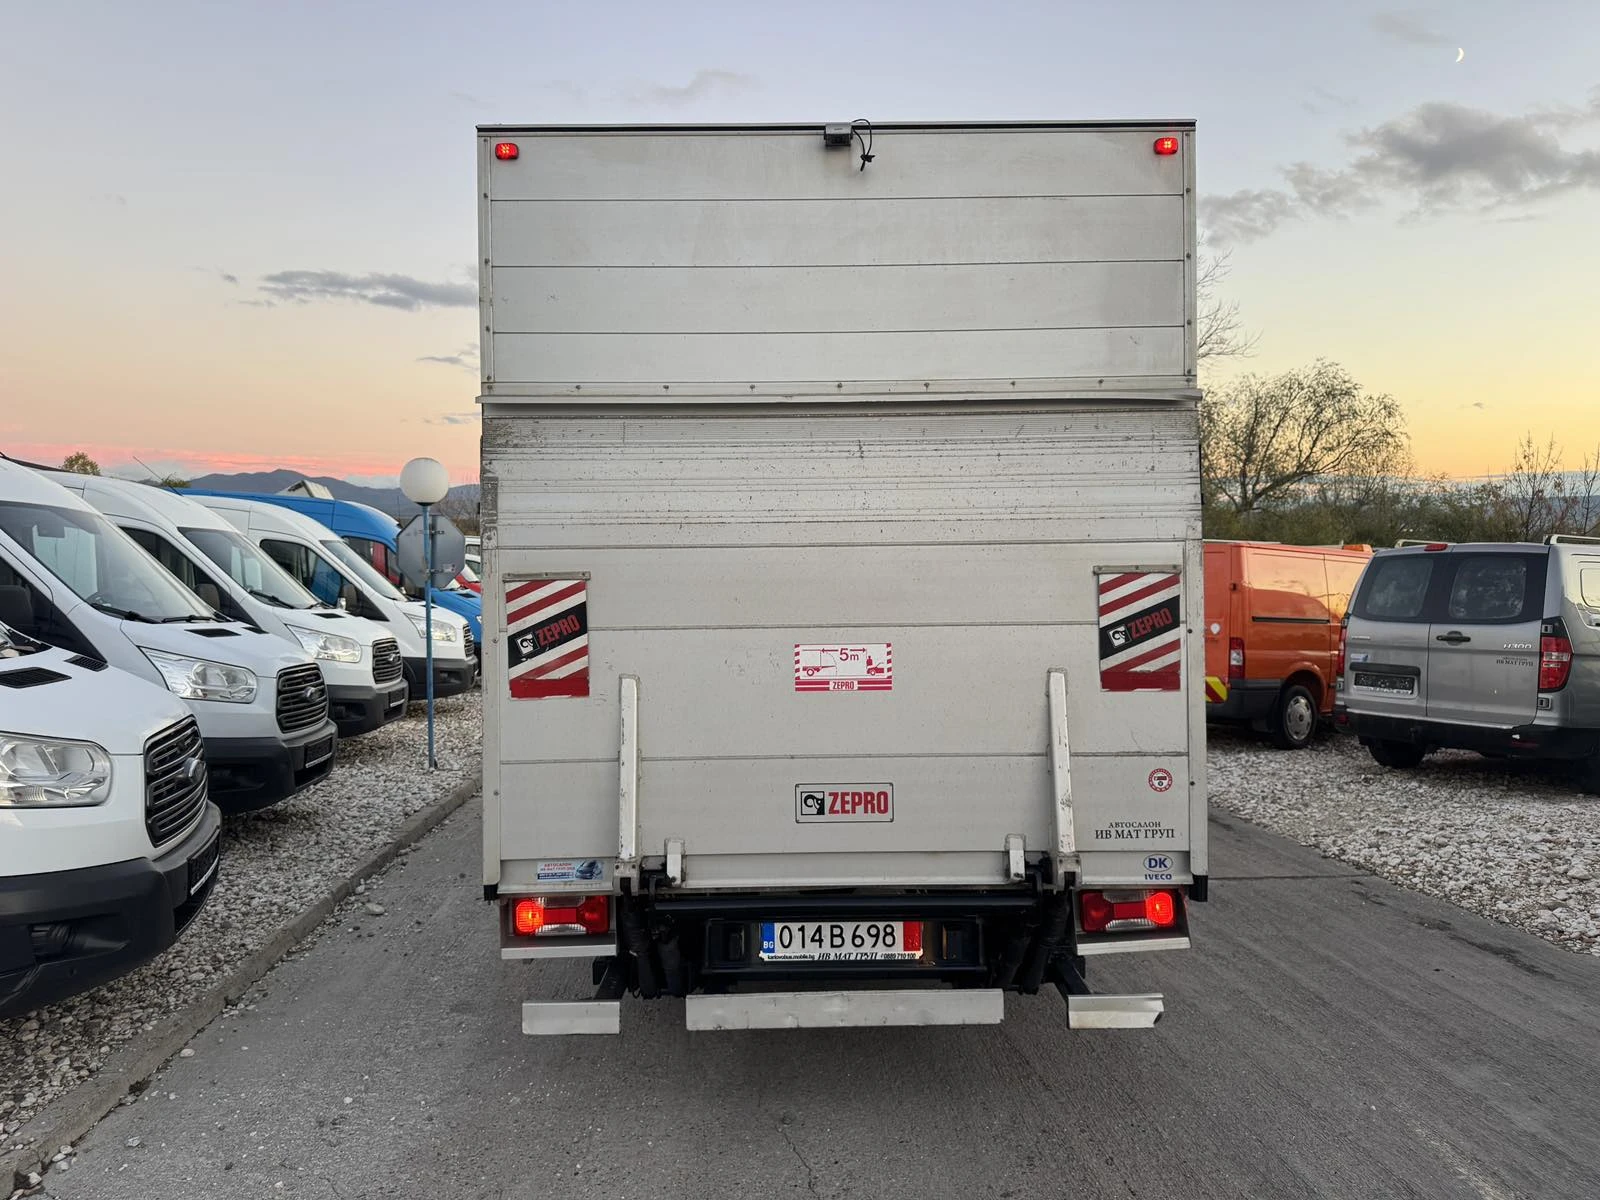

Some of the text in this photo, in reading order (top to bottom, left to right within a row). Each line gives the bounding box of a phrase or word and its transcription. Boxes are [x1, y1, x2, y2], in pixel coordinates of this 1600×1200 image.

[1127, 608, 1173, 639] ZEPRO
[536, 614, 581, 647] ZEPRO
[832, 681, 855, 690] ZEPRO
[828, 791, 889, 814] ZEPRO
[1108, 821, 1161, 829] АВТОСАЛОН
[1095, 829, 1175, 839] ИВ МАТ ГРУП
[1148, 857, 1168, 869] DK
[763, 941, 774, 949] BG
